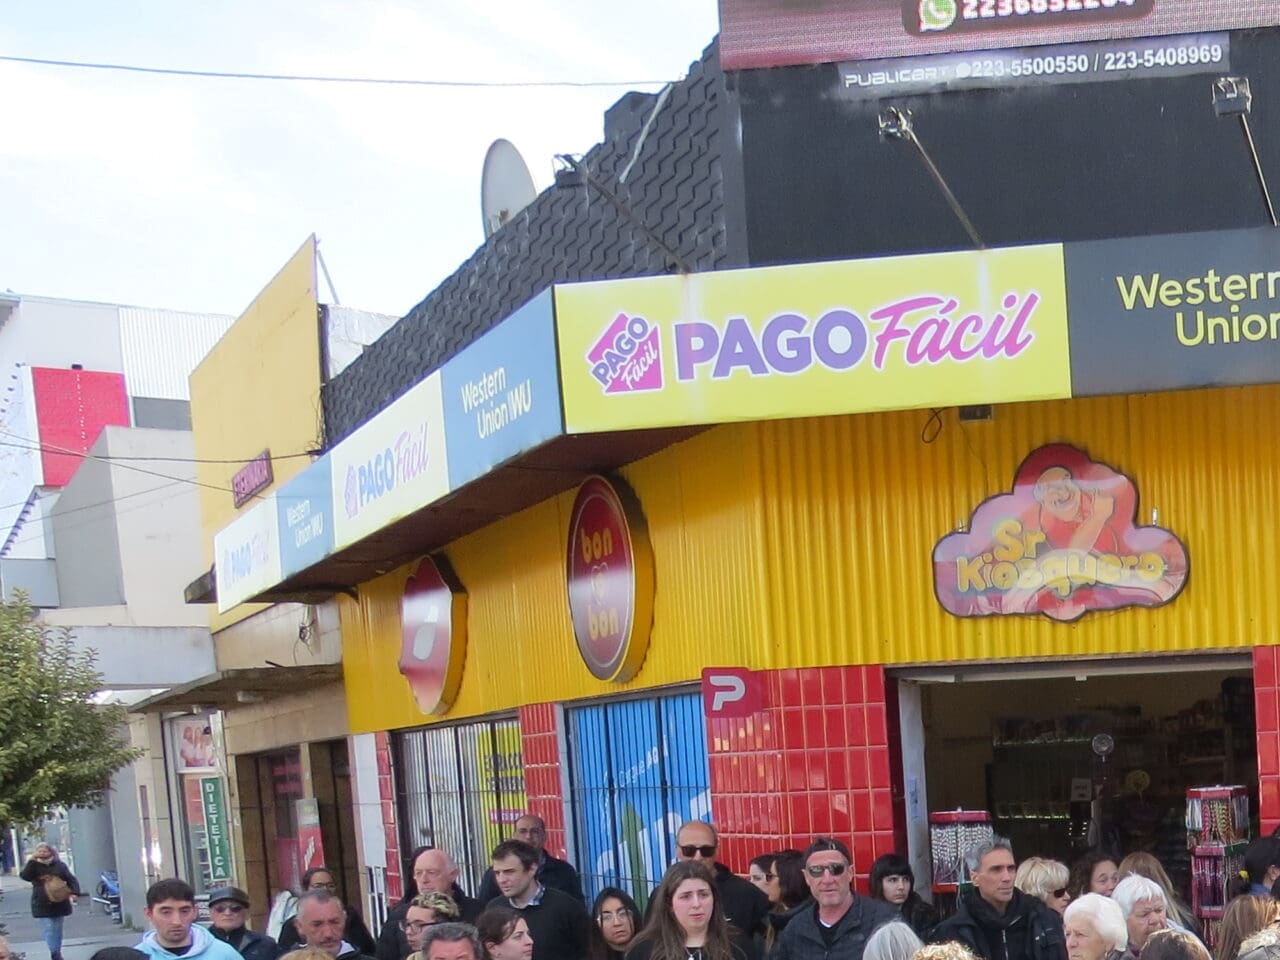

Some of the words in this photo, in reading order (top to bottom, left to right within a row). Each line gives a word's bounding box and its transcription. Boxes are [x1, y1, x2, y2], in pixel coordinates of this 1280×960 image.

[971, 54, 1089, 78] 223-5500550
[1104, 45, 1222, 71] 223-5408969
[592, 316, 649, 386] PAGO
[673, 310, 868, 380] PAGO
[869, 293, 1039, 369] Fácil
[461, 367, 506, 414] Western
[477, 401, 508, 439] Union
[358, 447, 395, 508] PAGO
[580, 527, 613, 564] bon
[994, 519, 1046, 562] Sr
[588, 605, 620, 642] bon
[205, 783, 226, 877] DIETETICA
